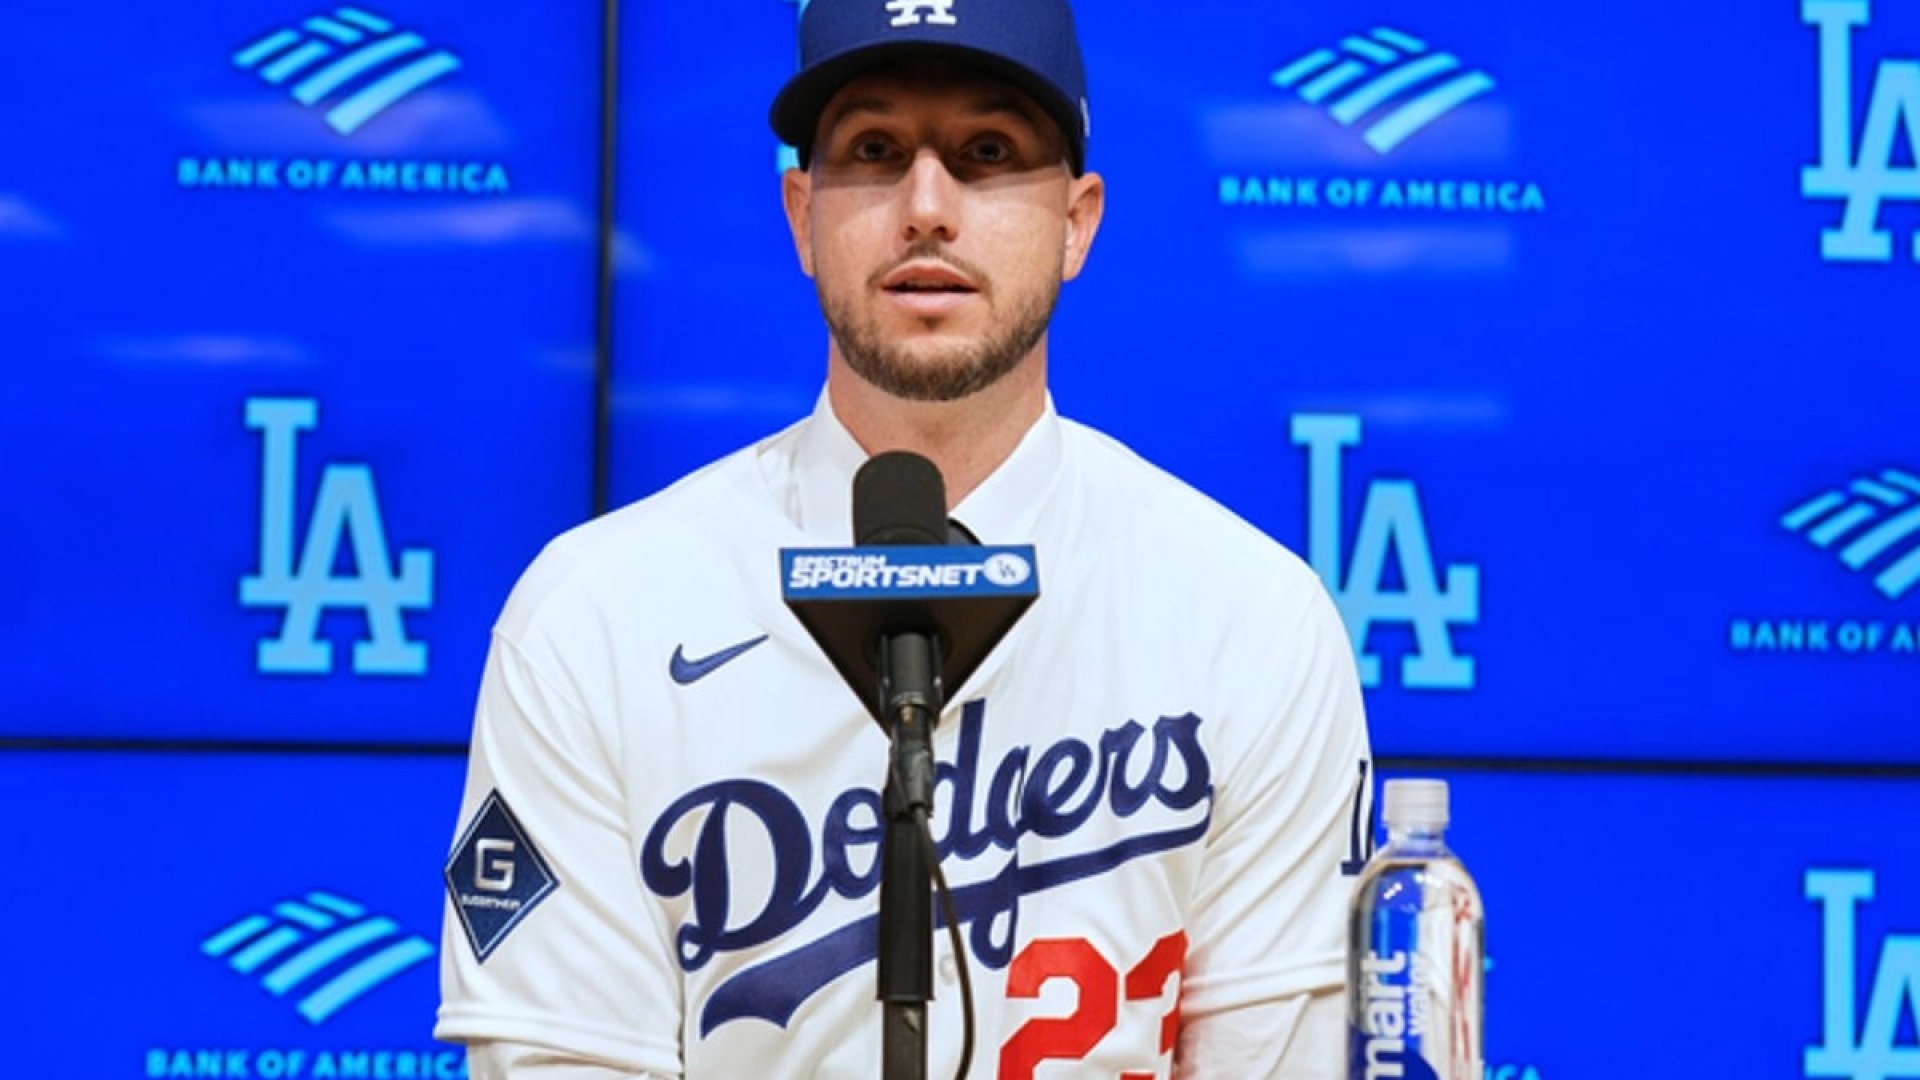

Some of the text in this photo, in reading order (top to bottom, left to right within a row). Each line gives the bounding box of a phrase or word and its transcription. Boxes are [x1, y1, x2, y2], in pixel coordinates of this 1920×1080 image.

[178, 159, 510, 192] BANK OF AMERICA
[1219, 176, 1545, 211] BANK OF AMERICA
[239, 397, 434, 677] LA
[1290, 413, 1479, 689] LA
[788, 563, 985, 588] SPORTSNET
[792, 555, 887, 570] SPECTRUM
[1731, 619, 1828, 652] BANK
[1837, 620, 1882, 652] OF
[641, 698, 1214, 971] Dodgers
[474, 838, 515, 891] G
[1360, 951, 1408, 1080] mart
[146, 1049, 469, 1080] BANK OF AMERIC
